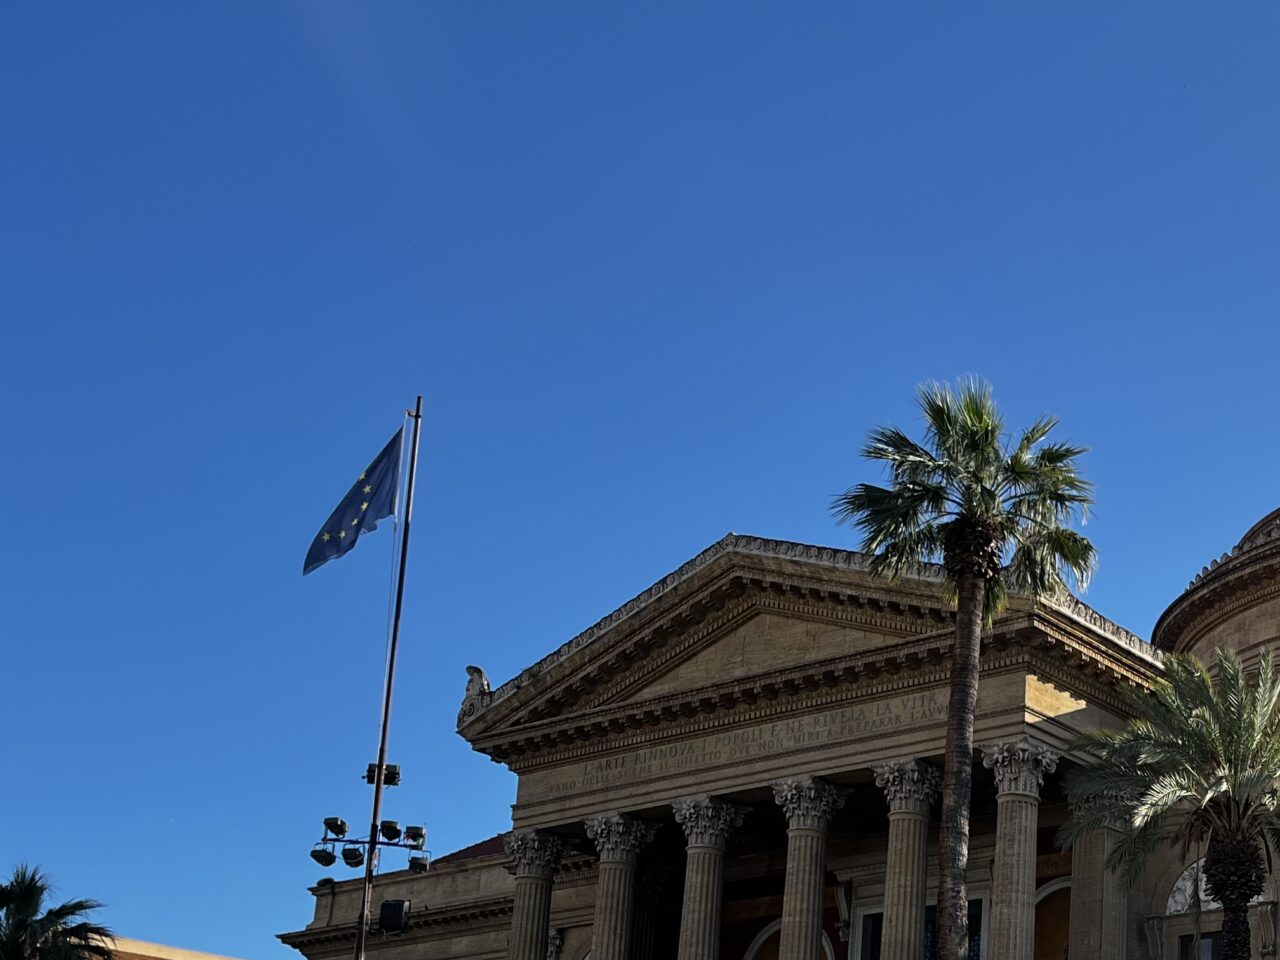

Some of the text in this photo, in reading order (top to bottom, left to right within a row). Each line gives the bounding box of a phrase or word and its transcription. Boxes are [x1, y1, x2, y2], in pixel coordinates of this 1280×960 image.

[635, 742, 695, 764] RINNOVA
[714, 727, 763, 749] POPOLI
[814, 706, 867, 729] RIVELA
[876, 702, 892, 717] LA
[901, 693, 938, 711] VITA
[759, 737, 784, 753] NON
[840, 715, 902, 736] PREPARAR
